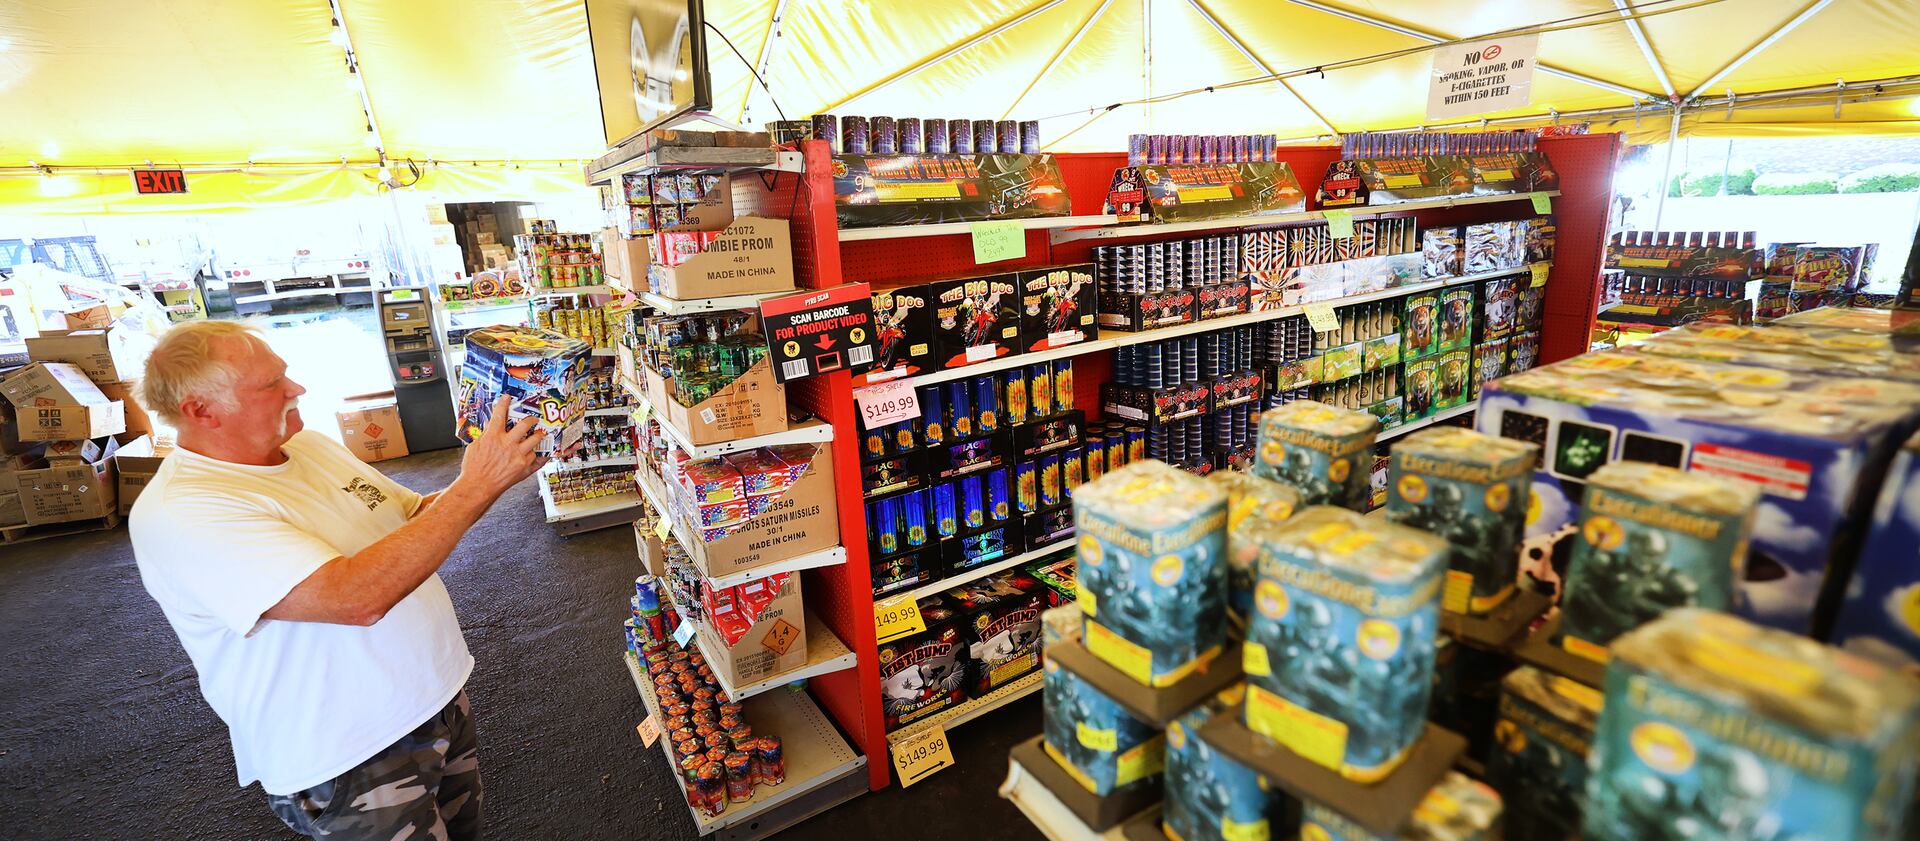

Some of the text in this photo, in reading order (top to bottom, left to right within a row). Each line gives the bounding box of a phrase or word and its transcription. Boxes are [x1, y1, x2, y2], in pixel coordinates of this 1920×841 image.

[1463, 51, 1480, 66] NO
[1478, 62, 1508, 76] VAPOR,
[1512, 59, 1524, 69] OR
[1451, 74, 1506, 92] E-CIGARETTES
[1444, 86, 1510, 105] WITHIN 150 FEET
[136, 172, 182, 192] EXIT
[854, 176, 864, 192] 9
[1332, 172, 1350, 181] WRECK
[1118, 182, 1134, 192] WRECK
[1336, 189, 1346, 197] 99
[1122, 202, 1130, 212] 99
[700, 238, 774, 254] OMBIE PROM
[708, 267, 776, 280] MADE IN CHINA
[1026, 271, 1093, 292] THE BIG DOG
[804, 292, 830, 306] PYRO SCAN
[940, 280, 1014, 303] THE BIG DOG
[1444, 290, 1472, 304] SABER TOOTH
[896, 295, 924, 308] DOG
[1408, 296, 1438, 312] SABER TOOTH
[790, 306, 850, 325] SCAN BARCODE
[776, 313, 868, 340] FOR PRODUCT VIDEO
[1440, 352, 1468, 366] SABER TOOTH
[1408, 360, 1436, 378] SABER TOOTH
[866, 396, 914, 420] $149.99
[762, 513, 788, 528] SATURN
[790, 505, 820, 518] MISSILES
[767, 526, 782, 536] 30/1
[749, 530, 806, 551] MADE IN CHINA
[734, 554, 760, 565] 1003549
[765, 608, 784, 621] PROM
[980, 608, 1038, 644] FIST BUMP
[882, 642, 952, 680] FIST BUMP
[896, 688, 948, 712] FIREWORKS
[898, 738, 944, 770] $149.99
